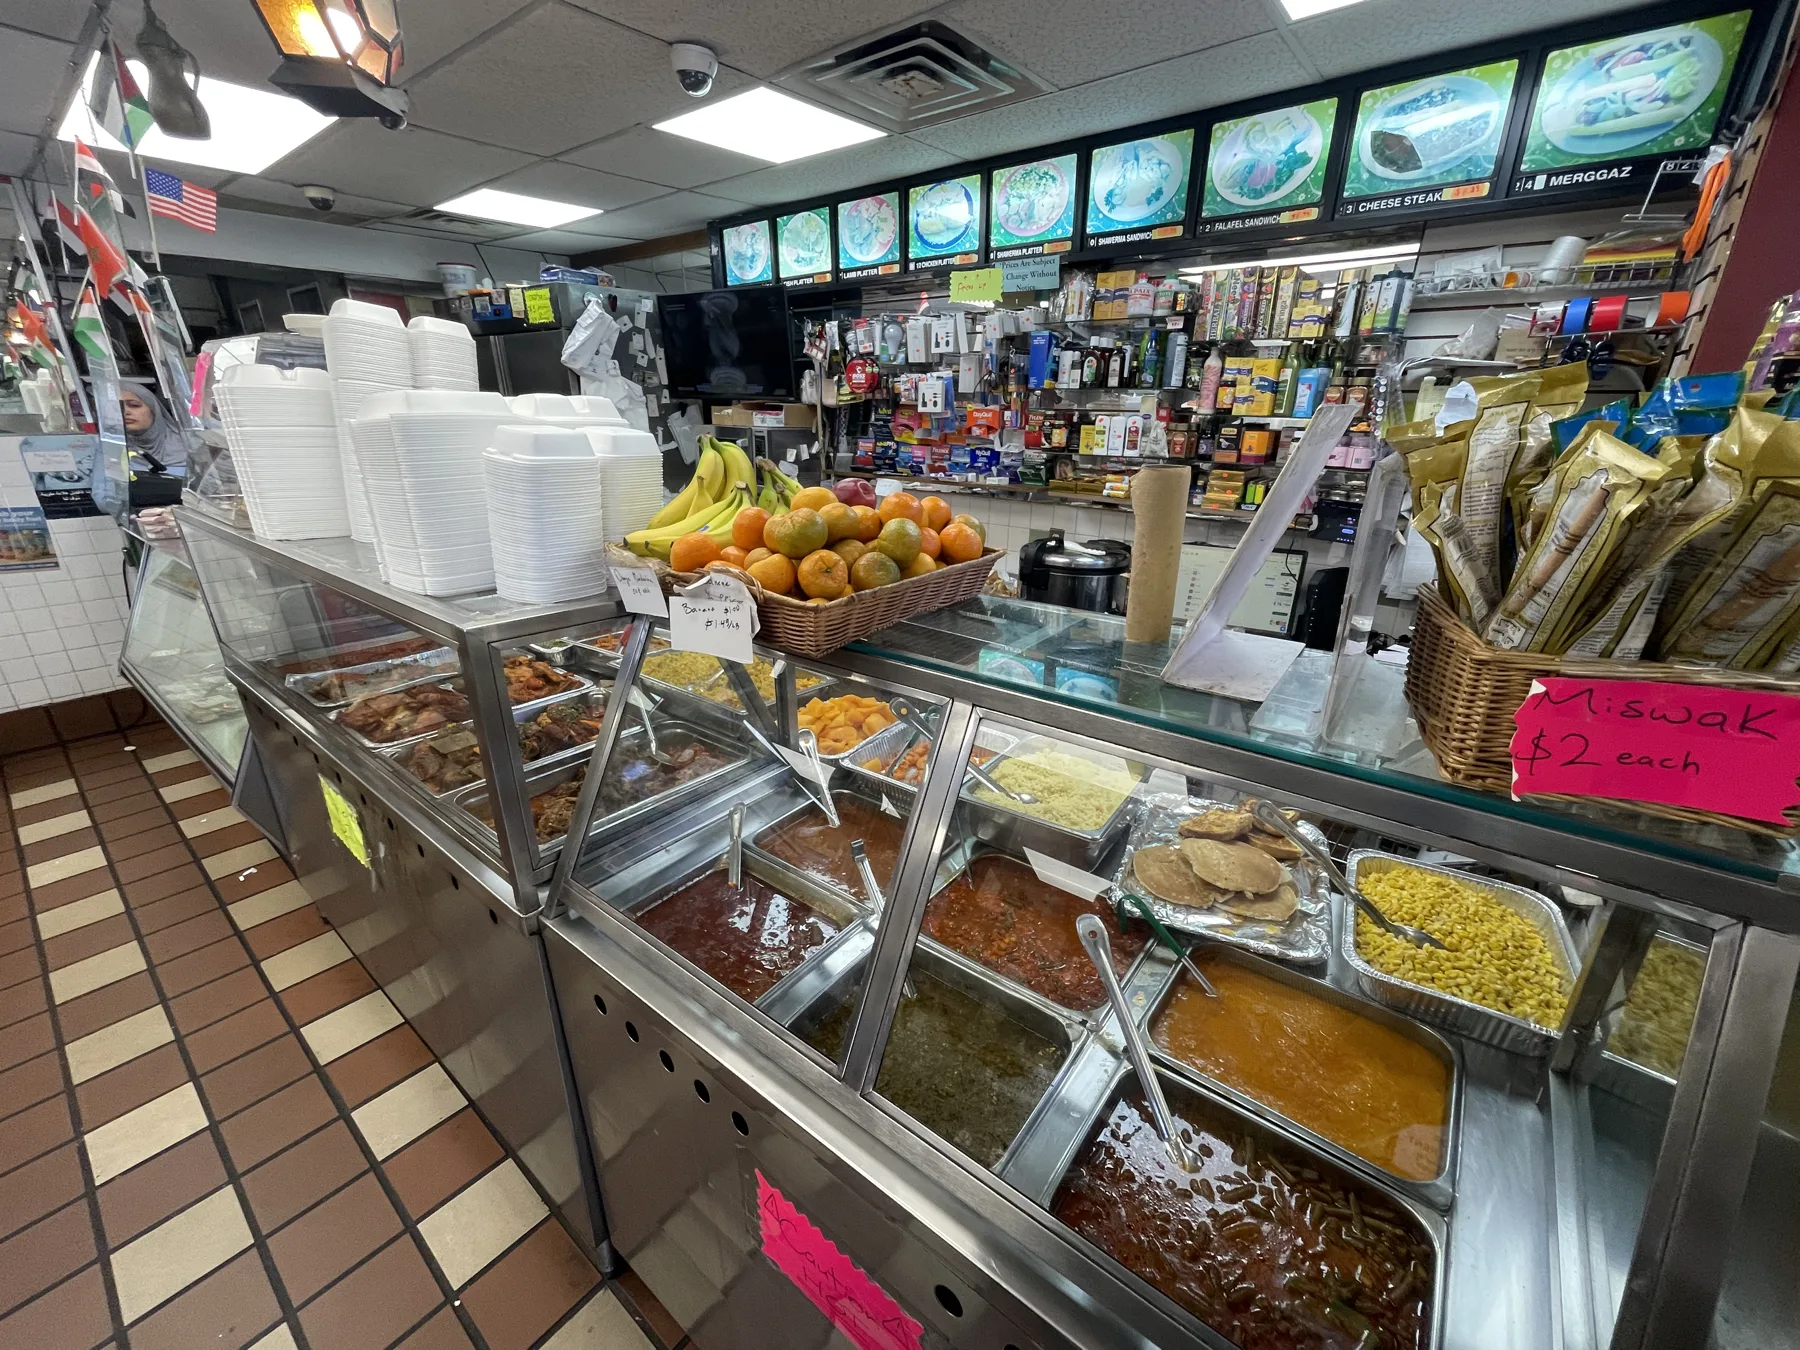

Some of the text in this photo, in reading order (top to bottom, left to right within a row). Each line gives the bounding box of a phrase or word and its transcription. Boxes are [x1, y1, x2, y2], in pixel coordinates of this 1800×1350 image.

[1549, 166, 1634, 188] MERGGAZ
[1358, 197, 1402, 212] CHEESE
[1403, 191, 1443, 206] STEAK
[1214, 219, 1244, 231] FALAFEL
[1244, 214, 1281, 228] SANDWICH
[1021, 245, 1043, 255] PLATTER
[1020, 259, 1031, 267] Are
[1032, 257, 1056, 268] Subject
[843, 268, 878, 279] LAMB PLATTER
[1005, 269, 1057, 282] Change Without
[793, 277, 814, 286] PLATTER
[1209, 307, 1220, 340] HERBAL
[1514, 727, 1701, 777] $2 each
